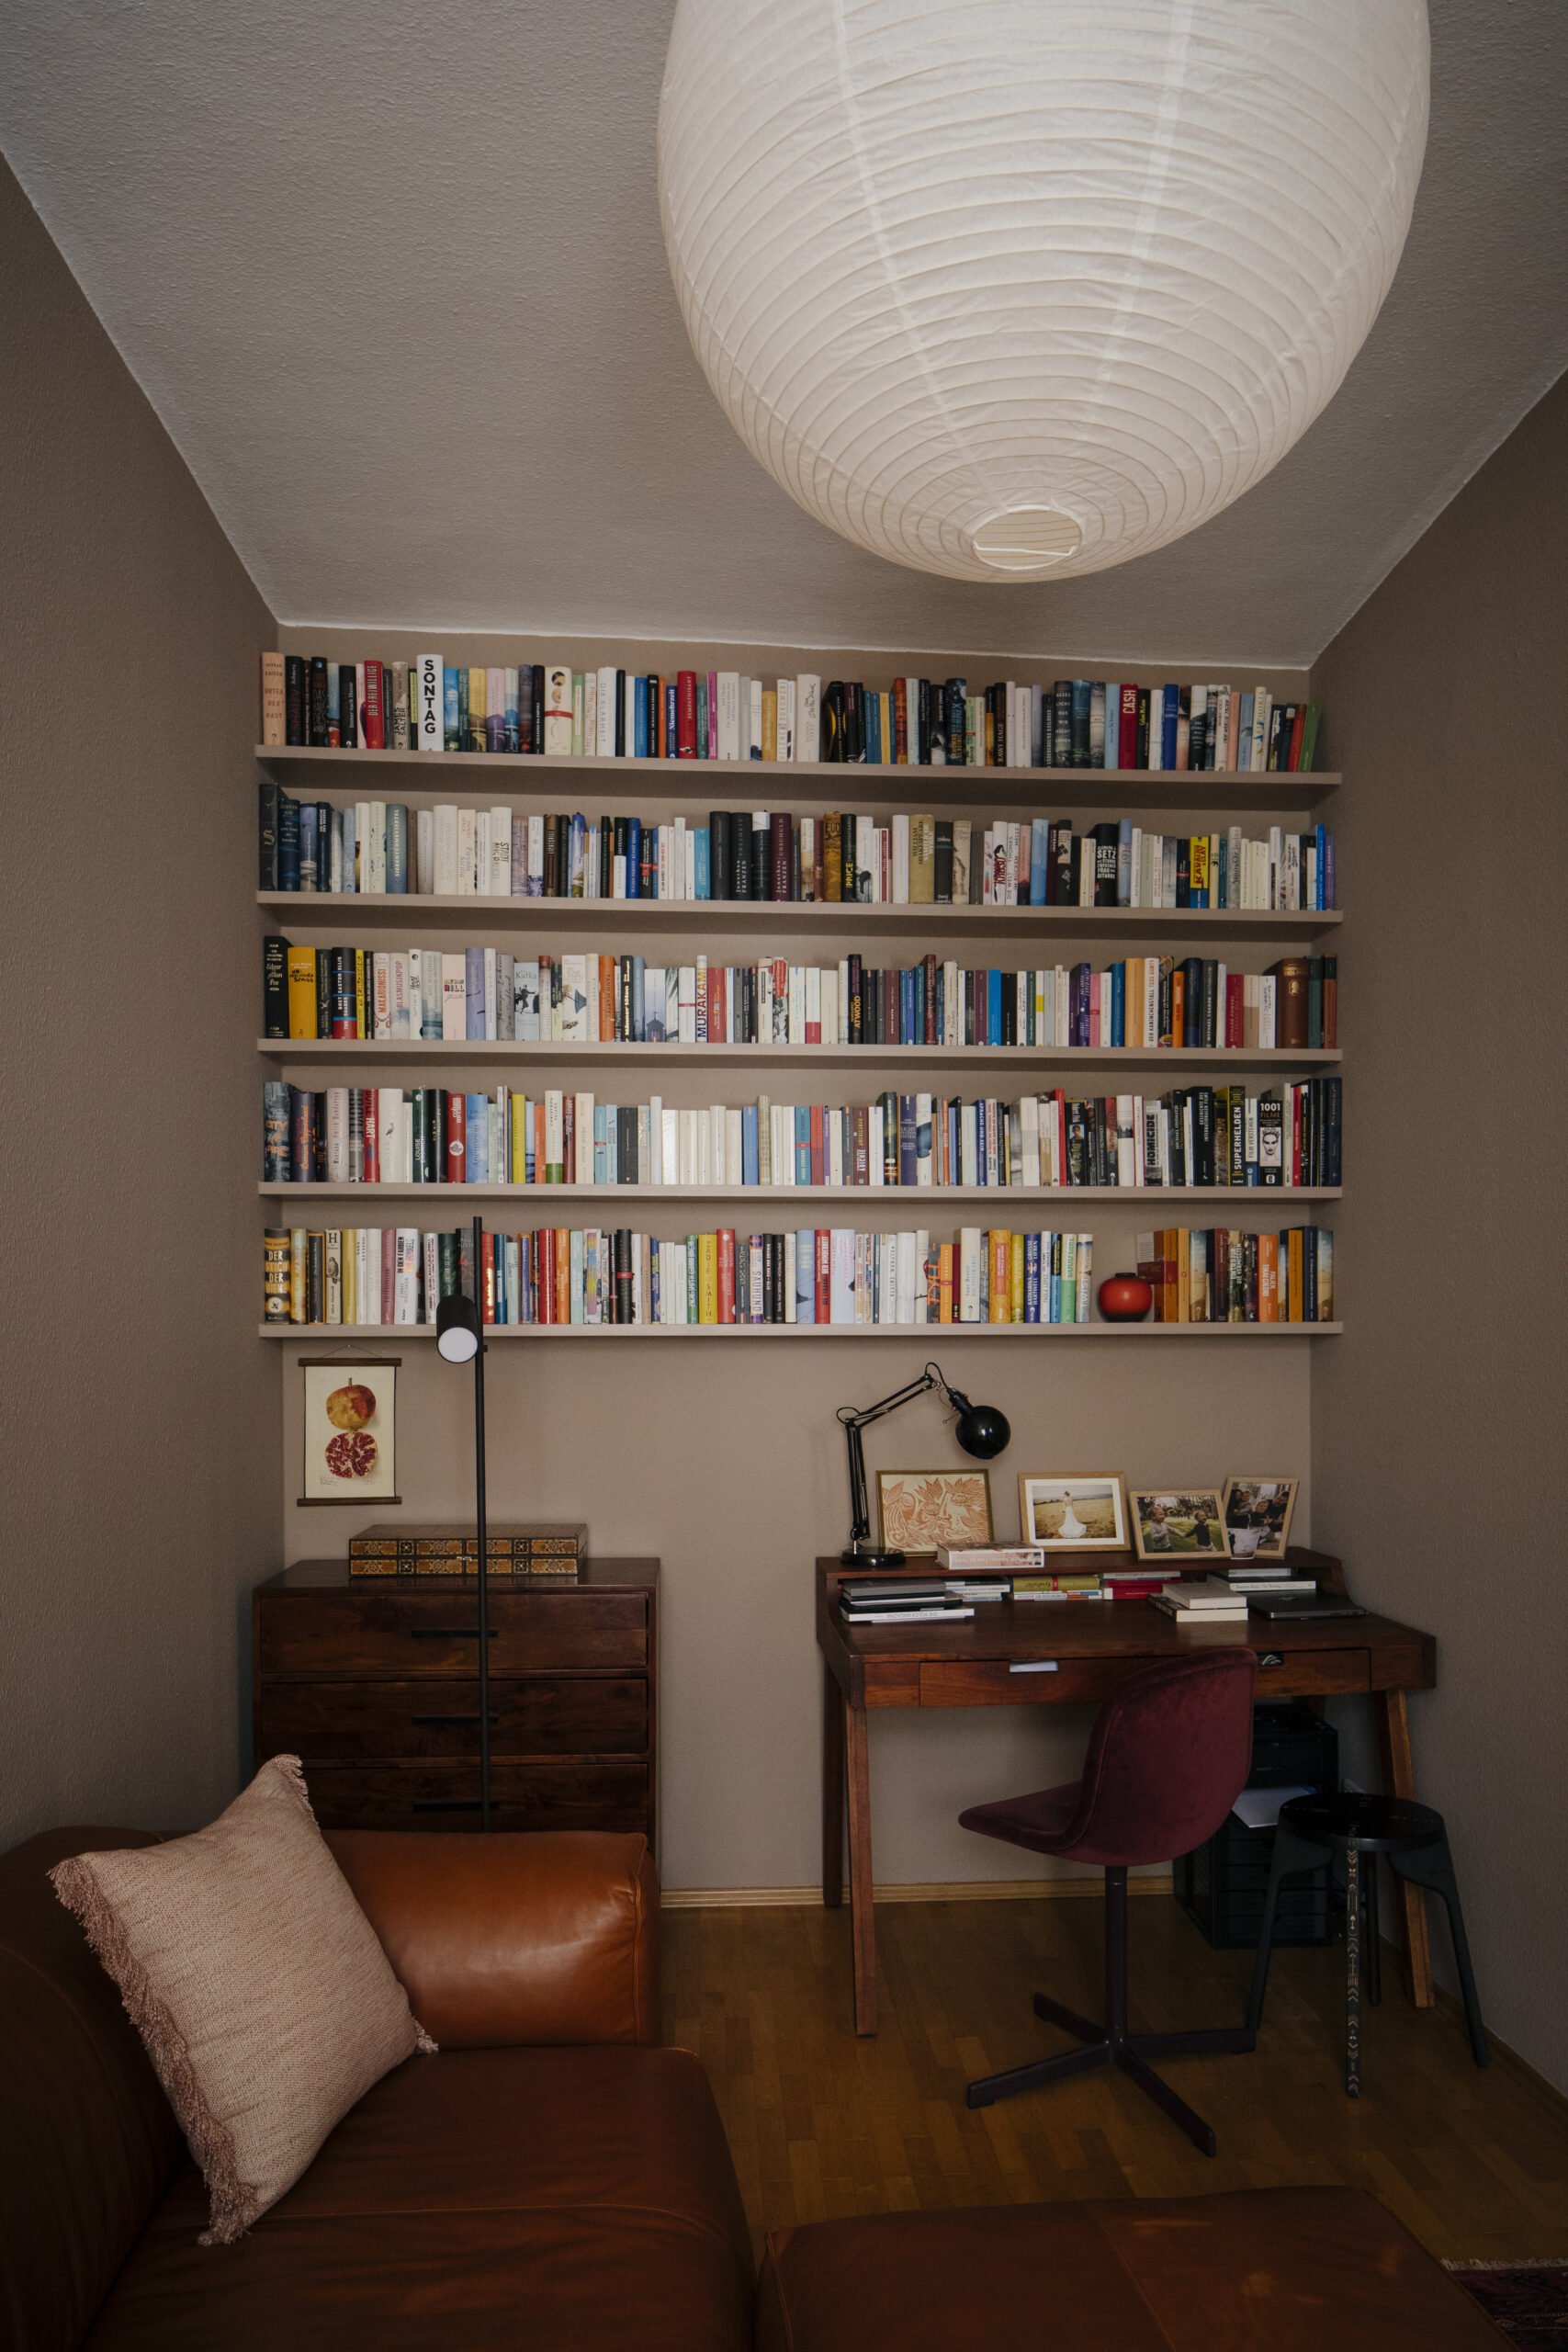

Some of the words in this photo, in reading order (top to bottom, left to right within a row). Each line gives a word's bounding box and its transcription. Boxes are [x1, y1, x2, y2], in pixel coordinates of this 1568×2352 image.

[423, 660, 435, 733] SONTAG
[1122, 691, 1135, 714] CASH
[367, 704, 378, 716] DER
[1097, 850, 1115, 858] SETZ
[378, 968, 386, 1012] MAKARIONISSI
[696, 967, 706, 1037] MURAKAMI
[1260, 1102, 1280, 1112] 1001
[366, 1117, 375, 1139] HART
[1146, 1114, 1156, 1165] HOMICIDE
[1234, 1106, 1242, 1170] SUPERHELDEN
[299, 1145, 309, 1170] Demon
[329, 1233, 338, 1244] H
[268, 1250, 283, 1261] DER
[268, 1273, 283, 1283] DER
[927, 1258, 941, 1306] TYLL
[753, 1271, 761, 1312] SAUHUND
